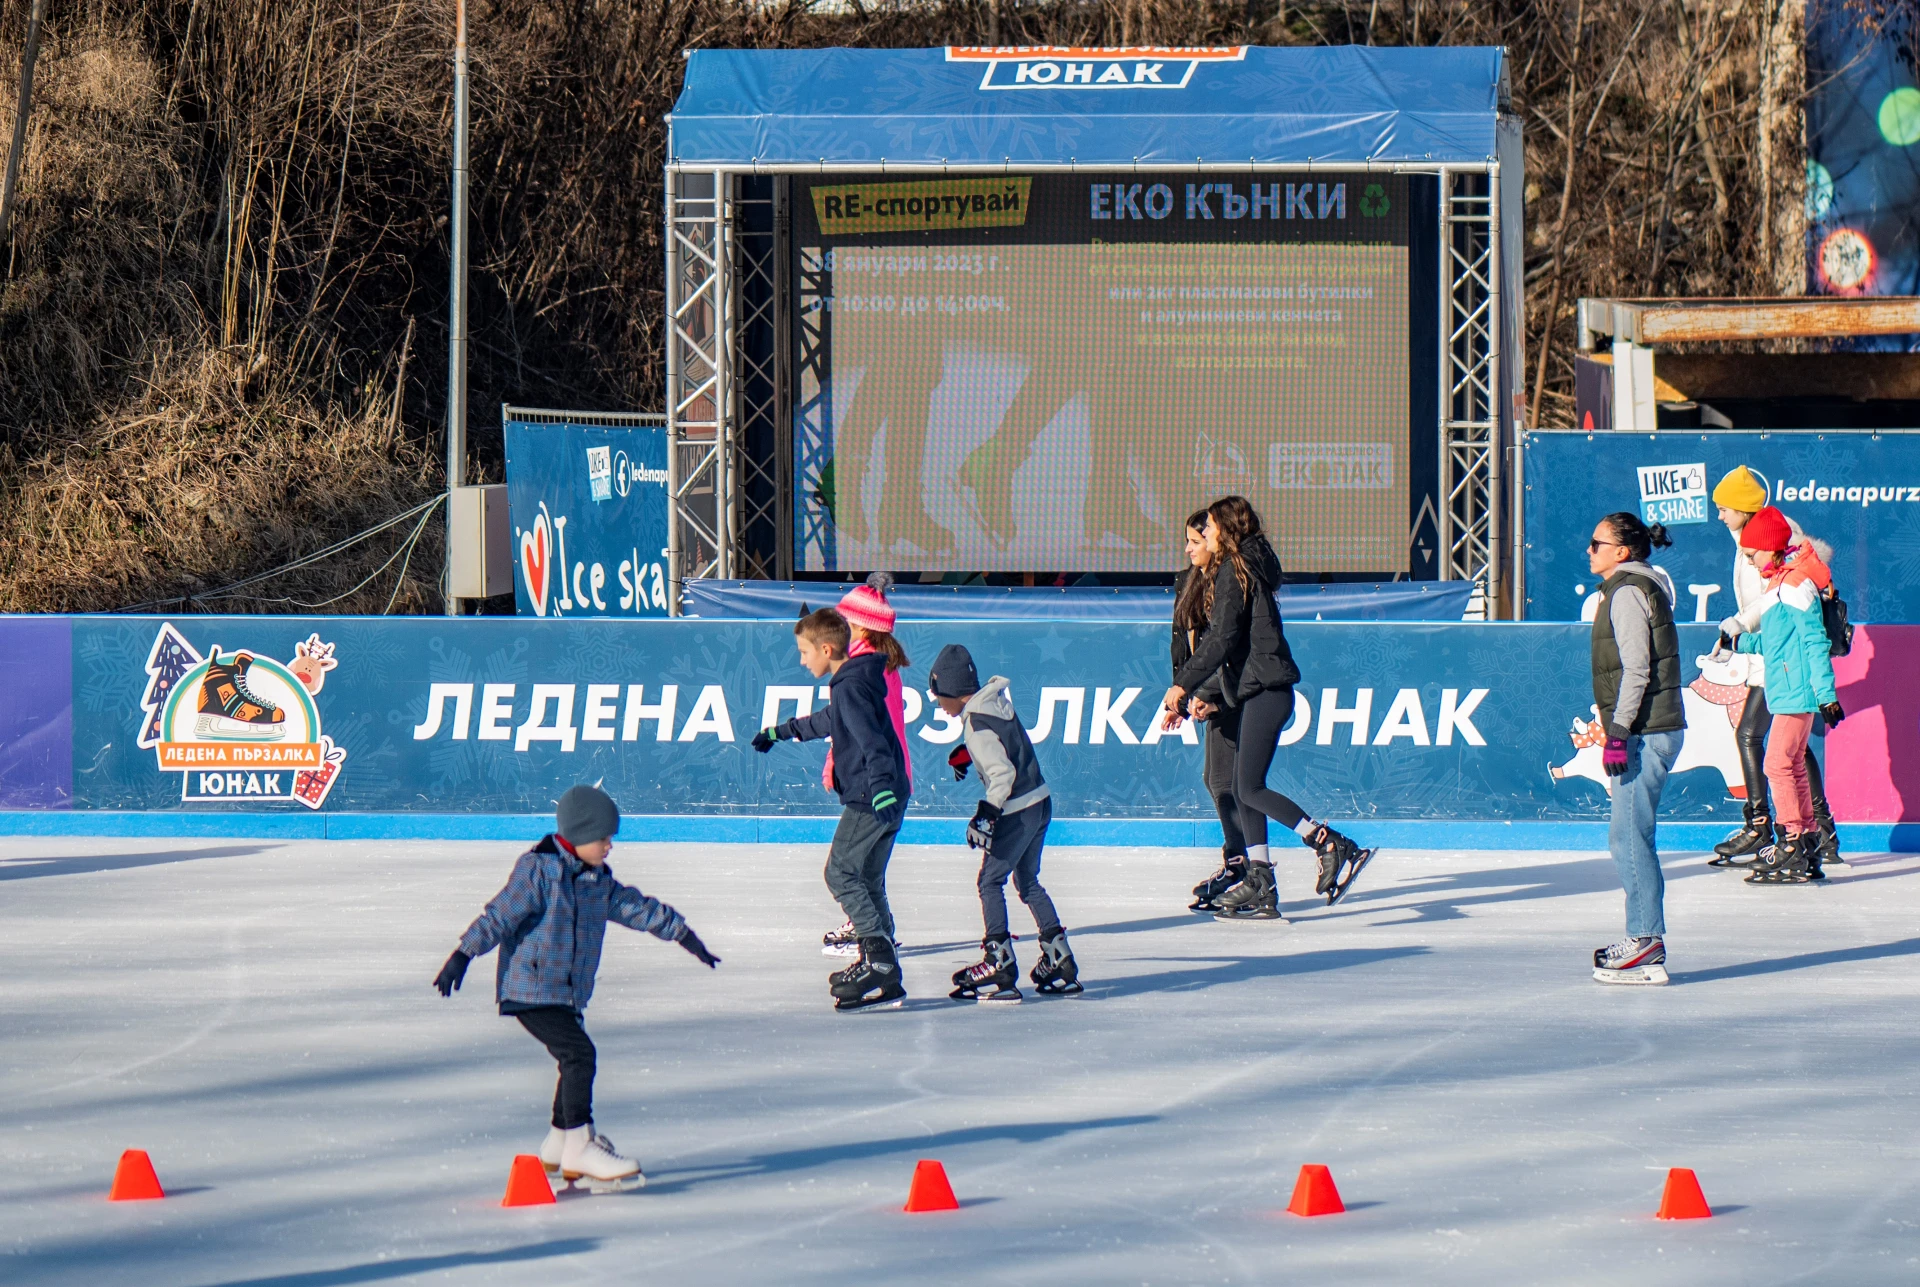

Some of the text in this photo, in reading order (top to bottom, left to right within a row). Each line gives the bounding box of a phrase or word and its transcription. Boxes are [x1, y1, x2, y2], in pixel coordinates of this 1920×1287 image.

[1015, 62, 1164, 83] ЮНАК
[824, 185, 1020, 221] RE-спортувай
[1090, 183, 1346, 219] ЕКО КЪНКИ
[842, 255, 928, 277] януари
[933, 254, 984, 275] 2023
[1109, 281, 1374, 303] или 2кг пластмасови бутилки
[841, 295, 896, 312] 10:00
[900, 296, 930, 316] до
[1140, 309, 1342, 326] и алуминиеви кенчета
[1644, 470, 1680, 496] LIKE
[1775, 479, 1920, 507] ledenapurz
[1646, 498, 1704, 522] & SHARE
[554, 515, 668, 614] Ice ska
[413, 682, 736, 752] ЛЕДЕНА
[759, 685, 1199, 744] ПРЗЛКА
[165, 747, 315, 762] ЛЕДЕНА ПЪРЗАЛКА
[200, 773, 281, 795] ЮНАК
